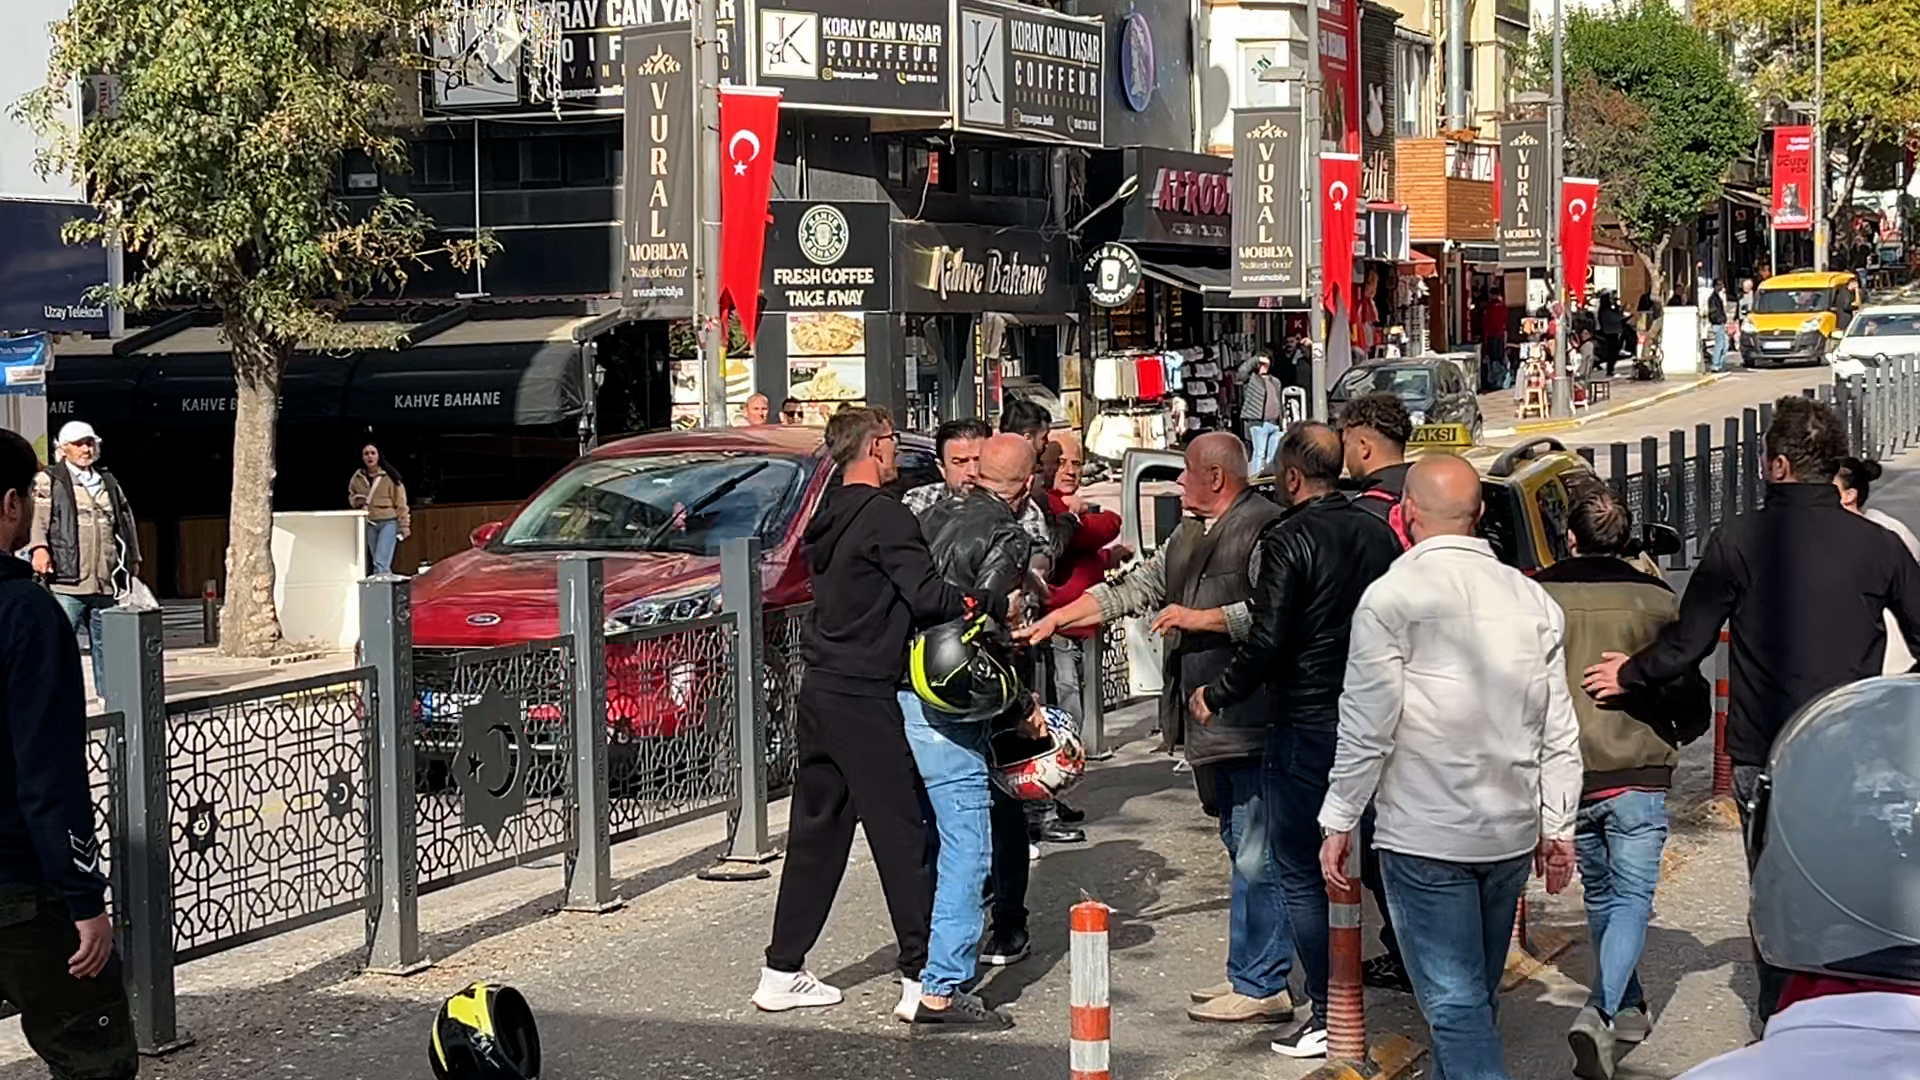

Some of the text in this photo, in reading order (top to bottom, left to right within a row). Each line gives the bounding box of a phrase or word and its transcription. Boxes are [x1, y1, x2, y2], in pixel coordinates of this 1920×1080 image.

[557, 0, 597, 28] RAY
[606, 0, 653, 27] CAN
[822, 17, 942, 46] KORAY CAN YAŞAR
[1011, 20, 1099, 68] KORAY CAN YAŞAR
[826, 40, 938, 63] COIFFEUR
[1015, 60, 1097, 96] COIFFEUR
[649, 82, 668, 237] VURAL
[1152, 168, 1232, 216] AFROD
[1257, 143, 1274, 243] VURAL
[1516, 149, 1530, 227] VURAL
[928, 245, 1048, 300] Kahve Bahane
[1083, 246, 1138, 274] TAKE AWAY
[773, 267, 874, 285] FRESH COFFEE
[44, 304, 104, 320] Uzay Telekom
[785, 289, 864, 307] TAKE AWAY
[48, 400, 75, 414] ANE
[181, 397, 227, 412] KAHVE
[394, 391, 501, 409] KAHVE BAHANE
